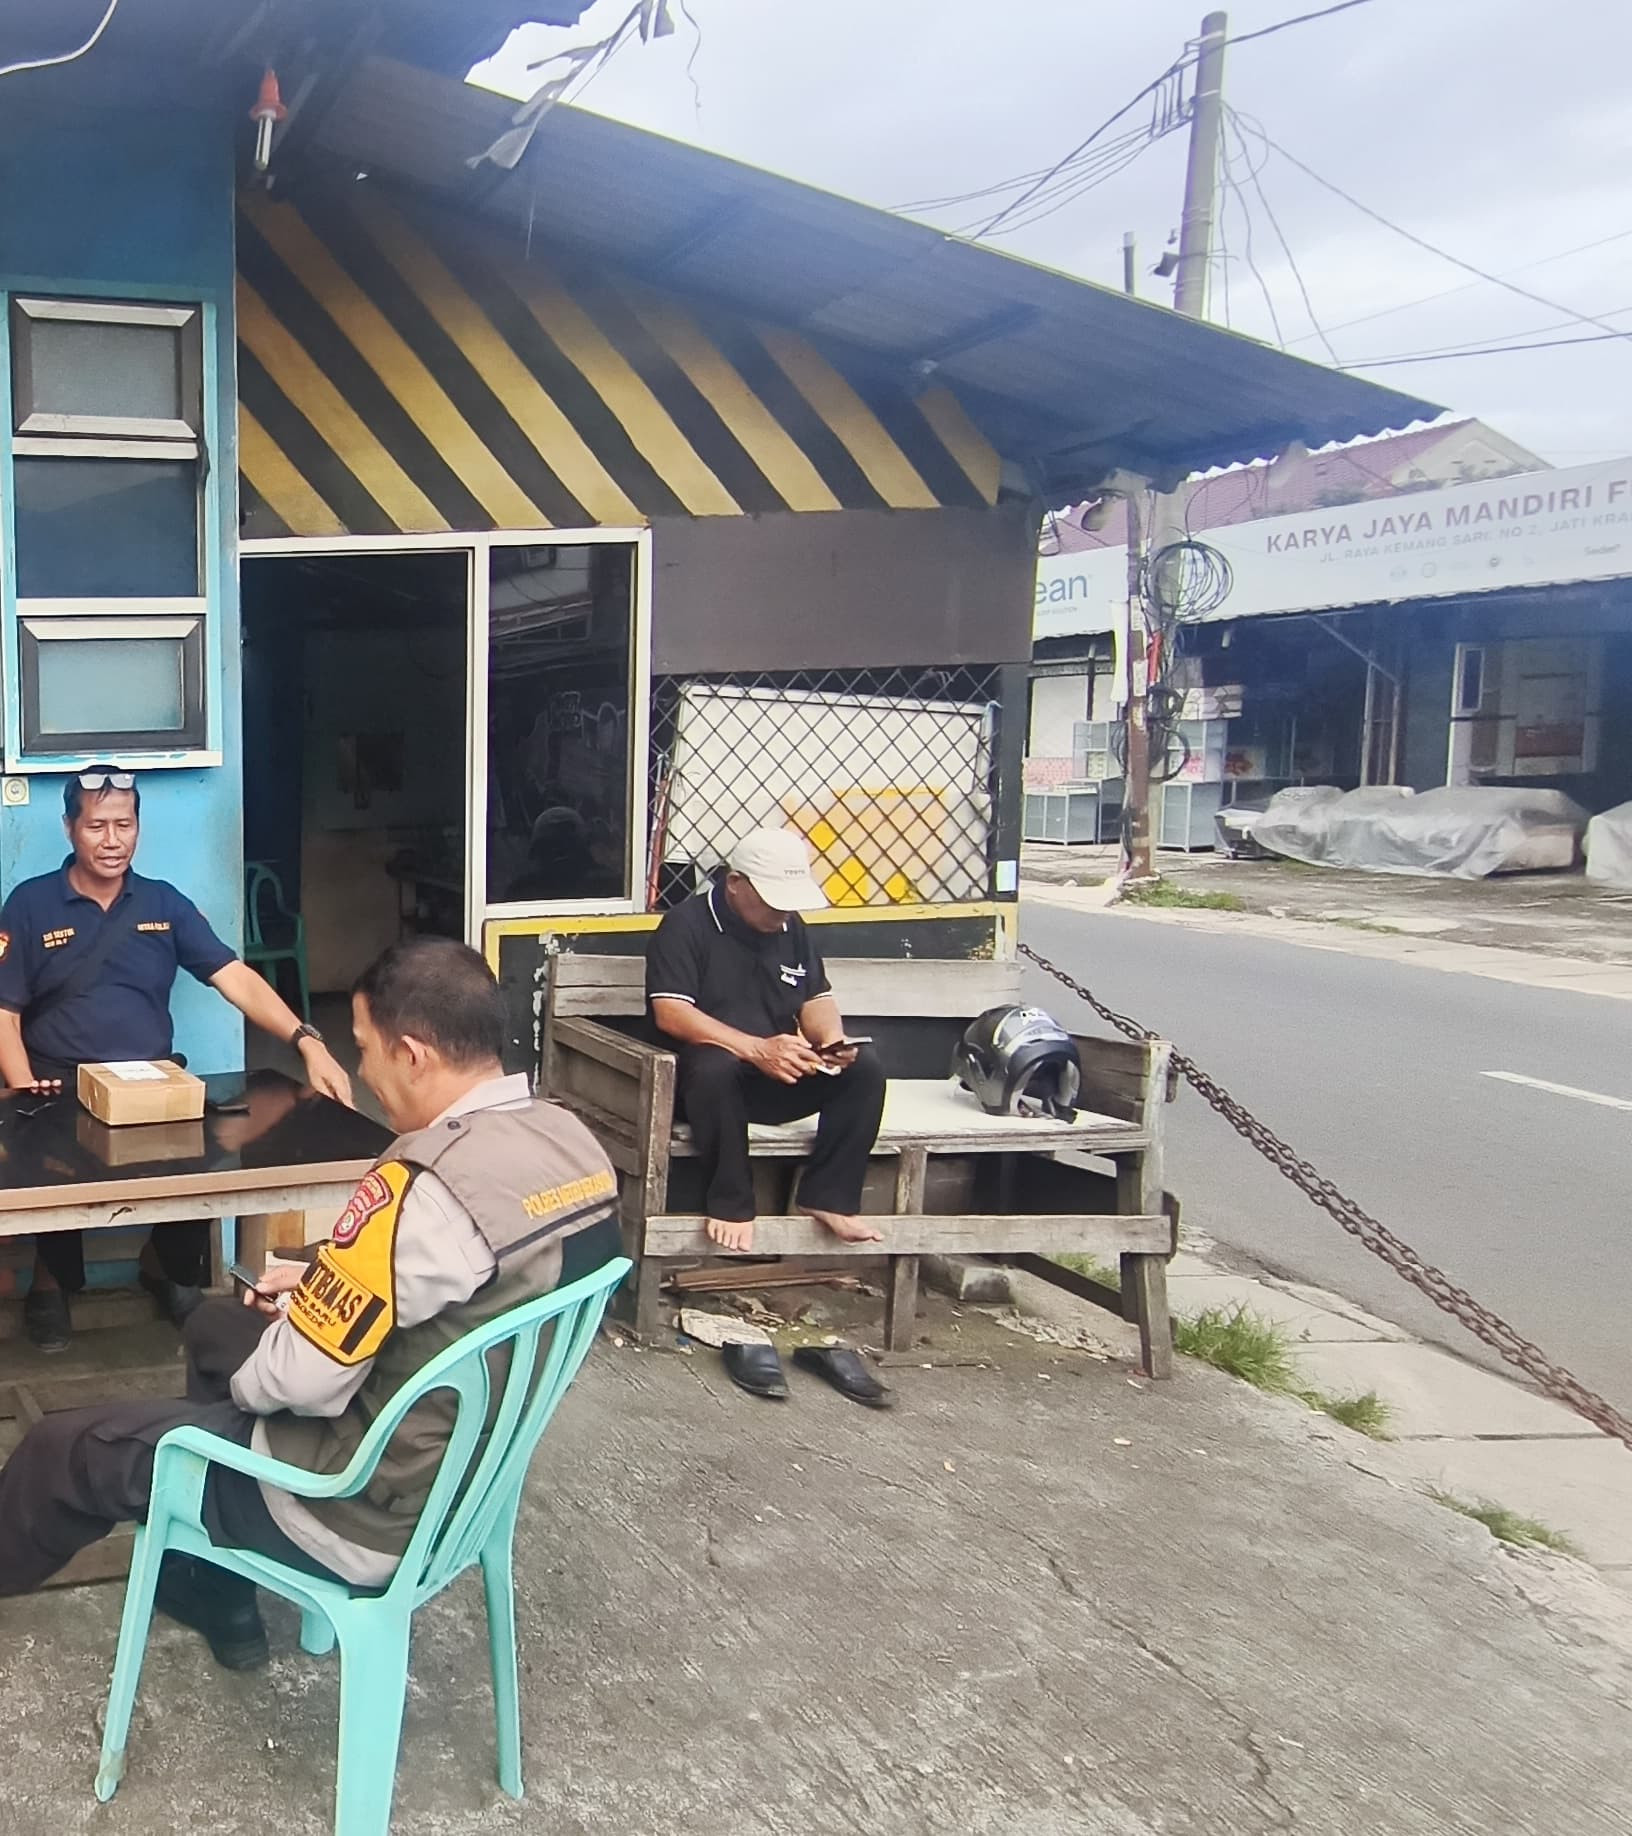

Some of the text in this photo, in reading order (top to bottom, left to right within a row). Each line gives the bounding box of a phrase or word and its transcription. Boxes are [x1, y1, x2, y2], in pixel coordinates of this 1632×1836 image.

[1266, 479, 1632, 554] KARYA JAYA MANDIRI F
[1384, 534, 1448, 555] KEMANG
[1591, 509, 1632, 528] KRA
